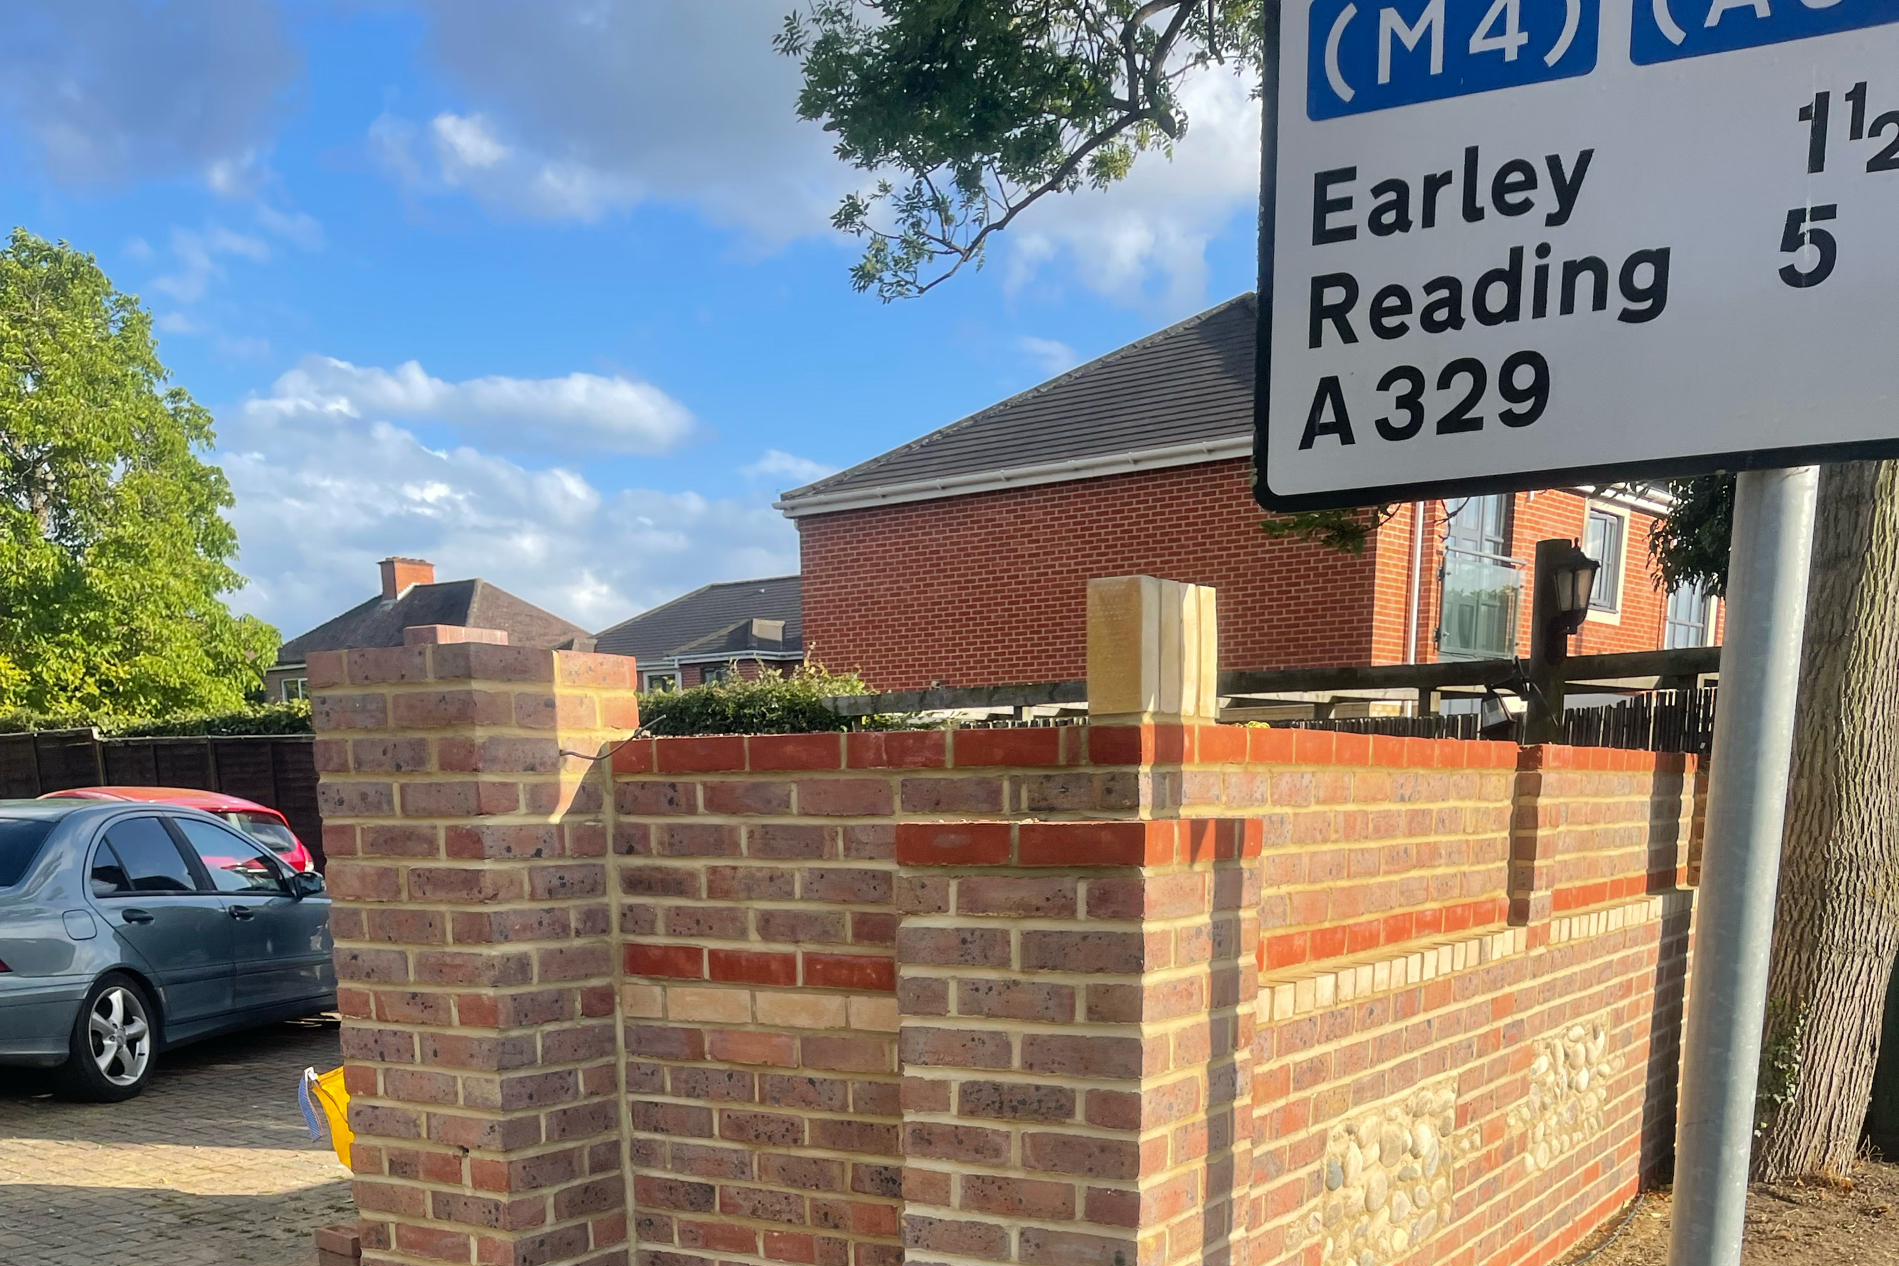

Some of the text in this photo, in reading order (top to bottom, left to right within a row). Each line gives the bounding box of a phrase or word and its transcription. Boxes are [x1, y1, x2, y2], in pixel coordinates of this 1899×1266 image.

[1324, 0, 1581, 102] (M4)
[1312, 146, 1595, 246] Earley
[1308, 204, 1838, 349] Reading 5
